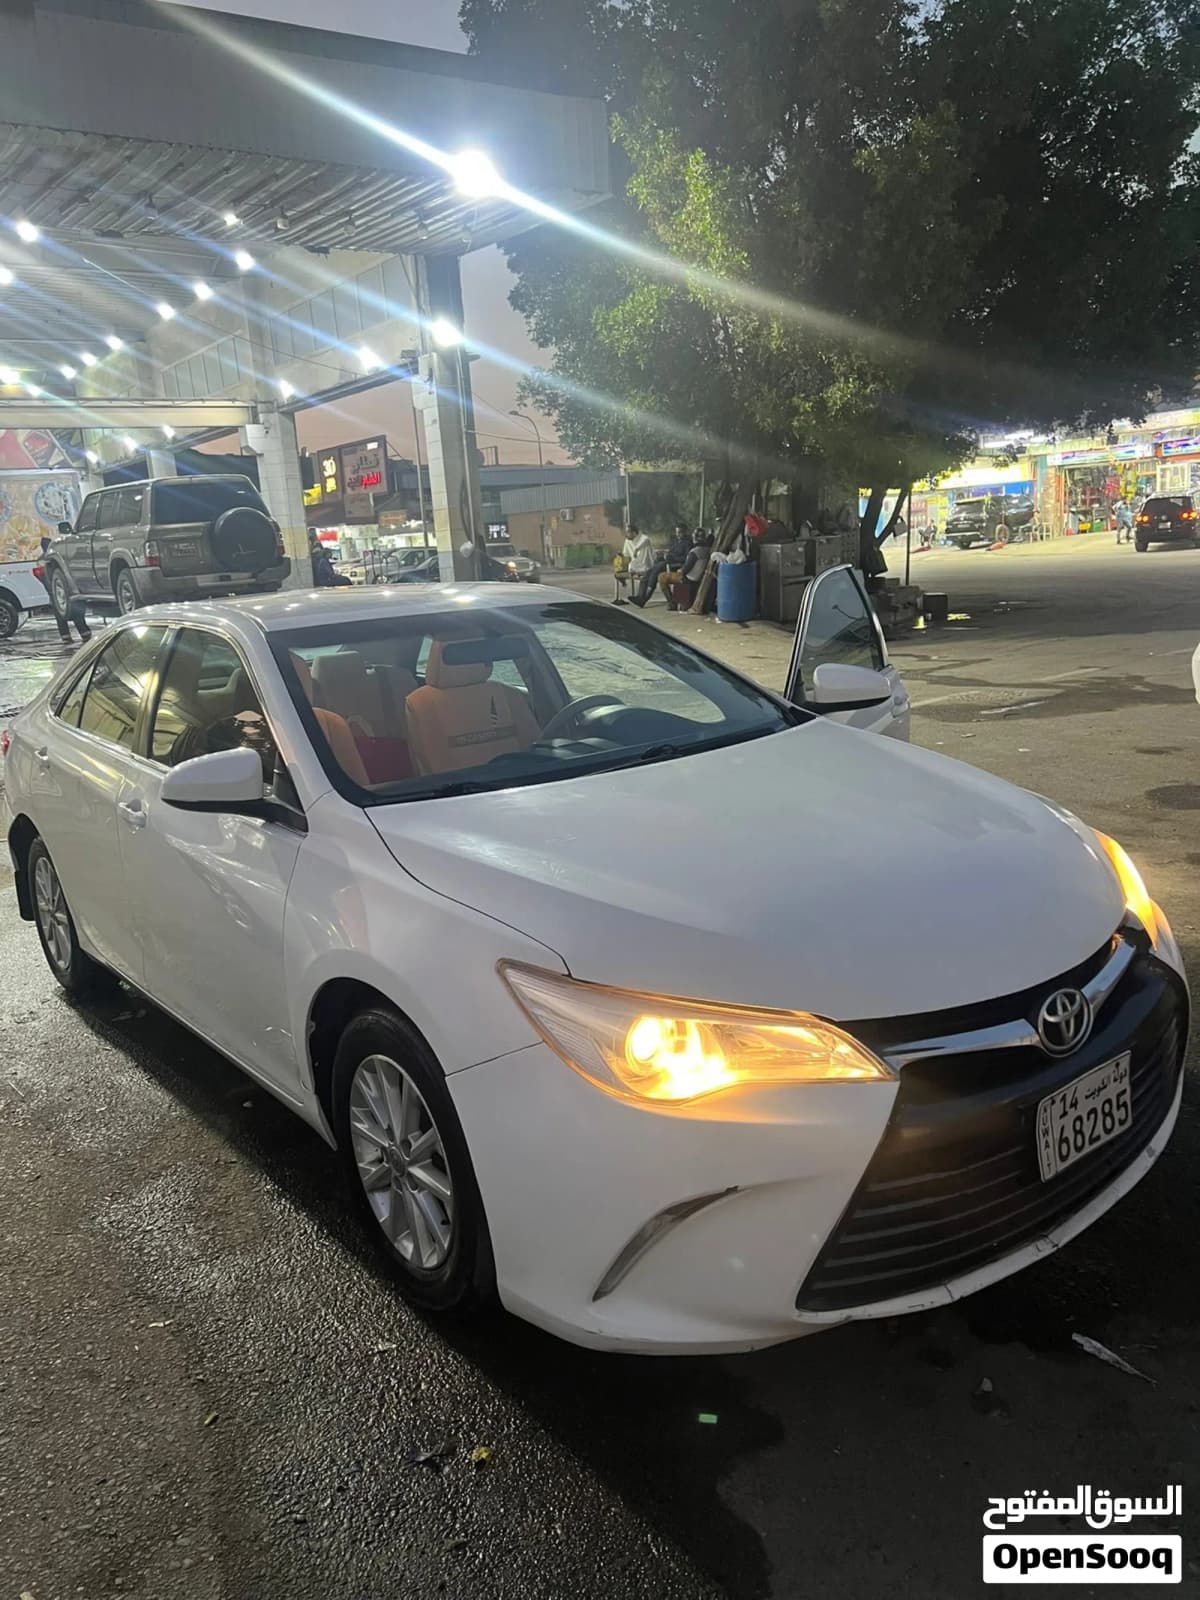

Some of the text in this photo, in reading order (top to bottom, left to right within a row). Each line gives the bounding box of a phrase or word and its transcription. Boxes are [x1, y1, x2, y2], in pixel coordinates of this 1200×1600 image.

[1059, 1086, 1079, 1119] 14
[1085, 1066, 1128, 1100] دولة الكويت
[1041, 1106, 1051, 1171] KUWAIT
[1058, 1088, 1129, 1162] 68285
